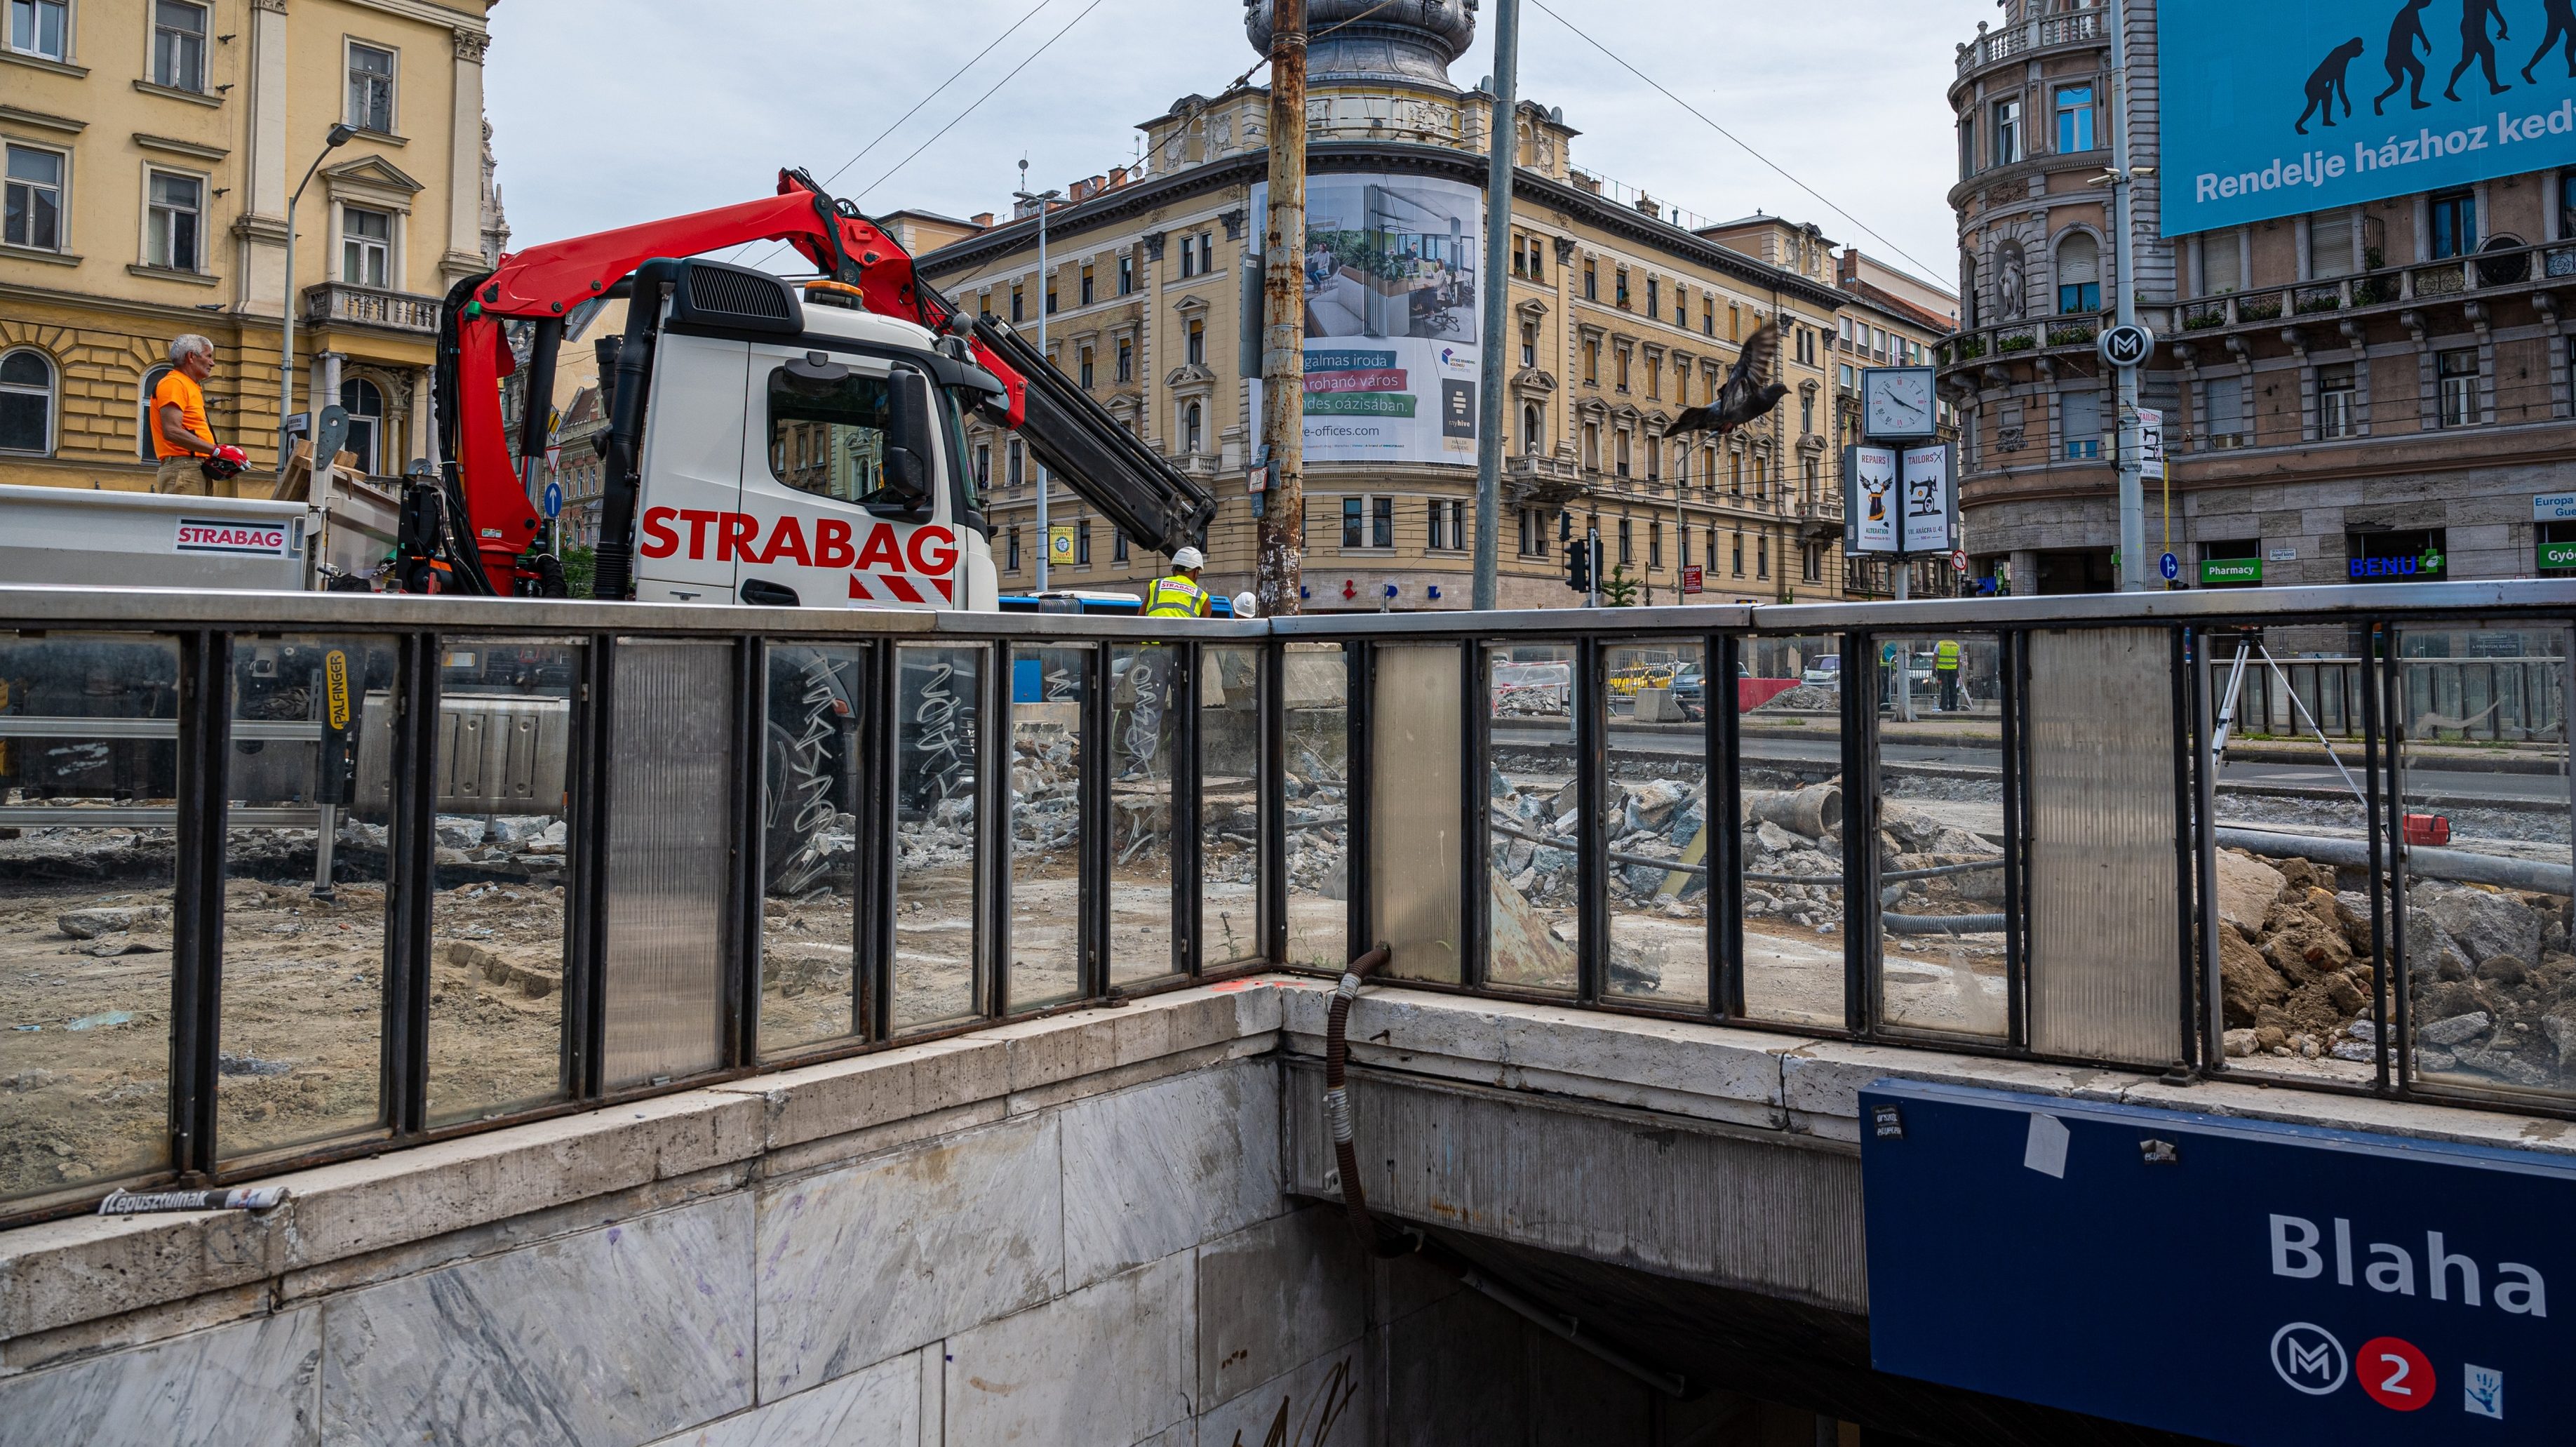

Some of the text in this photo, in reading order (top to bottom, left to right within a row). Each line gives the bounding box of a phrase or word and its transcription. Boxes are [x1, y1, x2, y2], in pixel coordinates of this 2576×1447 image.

[2196, 152, 2346, 204] Rendelje
[2355, 125, 2488, 173] házhoz
[1353, 354, 1387, 367] iroda
[1309, 375, 1356, 391] rohanó
[1360, 374, 1398, 387] város
[1335, 397, 1408, 412] oázisában.
[2139, 413, 2159, 422] TAILORS
[1861, 455, 1886, 465] REPAIRS
[1907, 453, 1934, 465] TAILORS
[2535, 498, 2574, 507] Europa
[178, 528, 283, 547] STRABAG
[1916, 526, 1932, 535] AKÁCFA
[640, 506, 959, 576] STRABAG
[2548, 549, 2576, 563] Gyó
[2209, 566, 2254, 575] Pharmacy
[2351, 556, 2417, 577] BENU
[1161, 582, 1195, 594] STRABAG
[330, 655, 347, 724] PALFINGER
[2269, 1213, 2547, 1318] Blaha
[2380, 1353, 2412, 1395] 2
